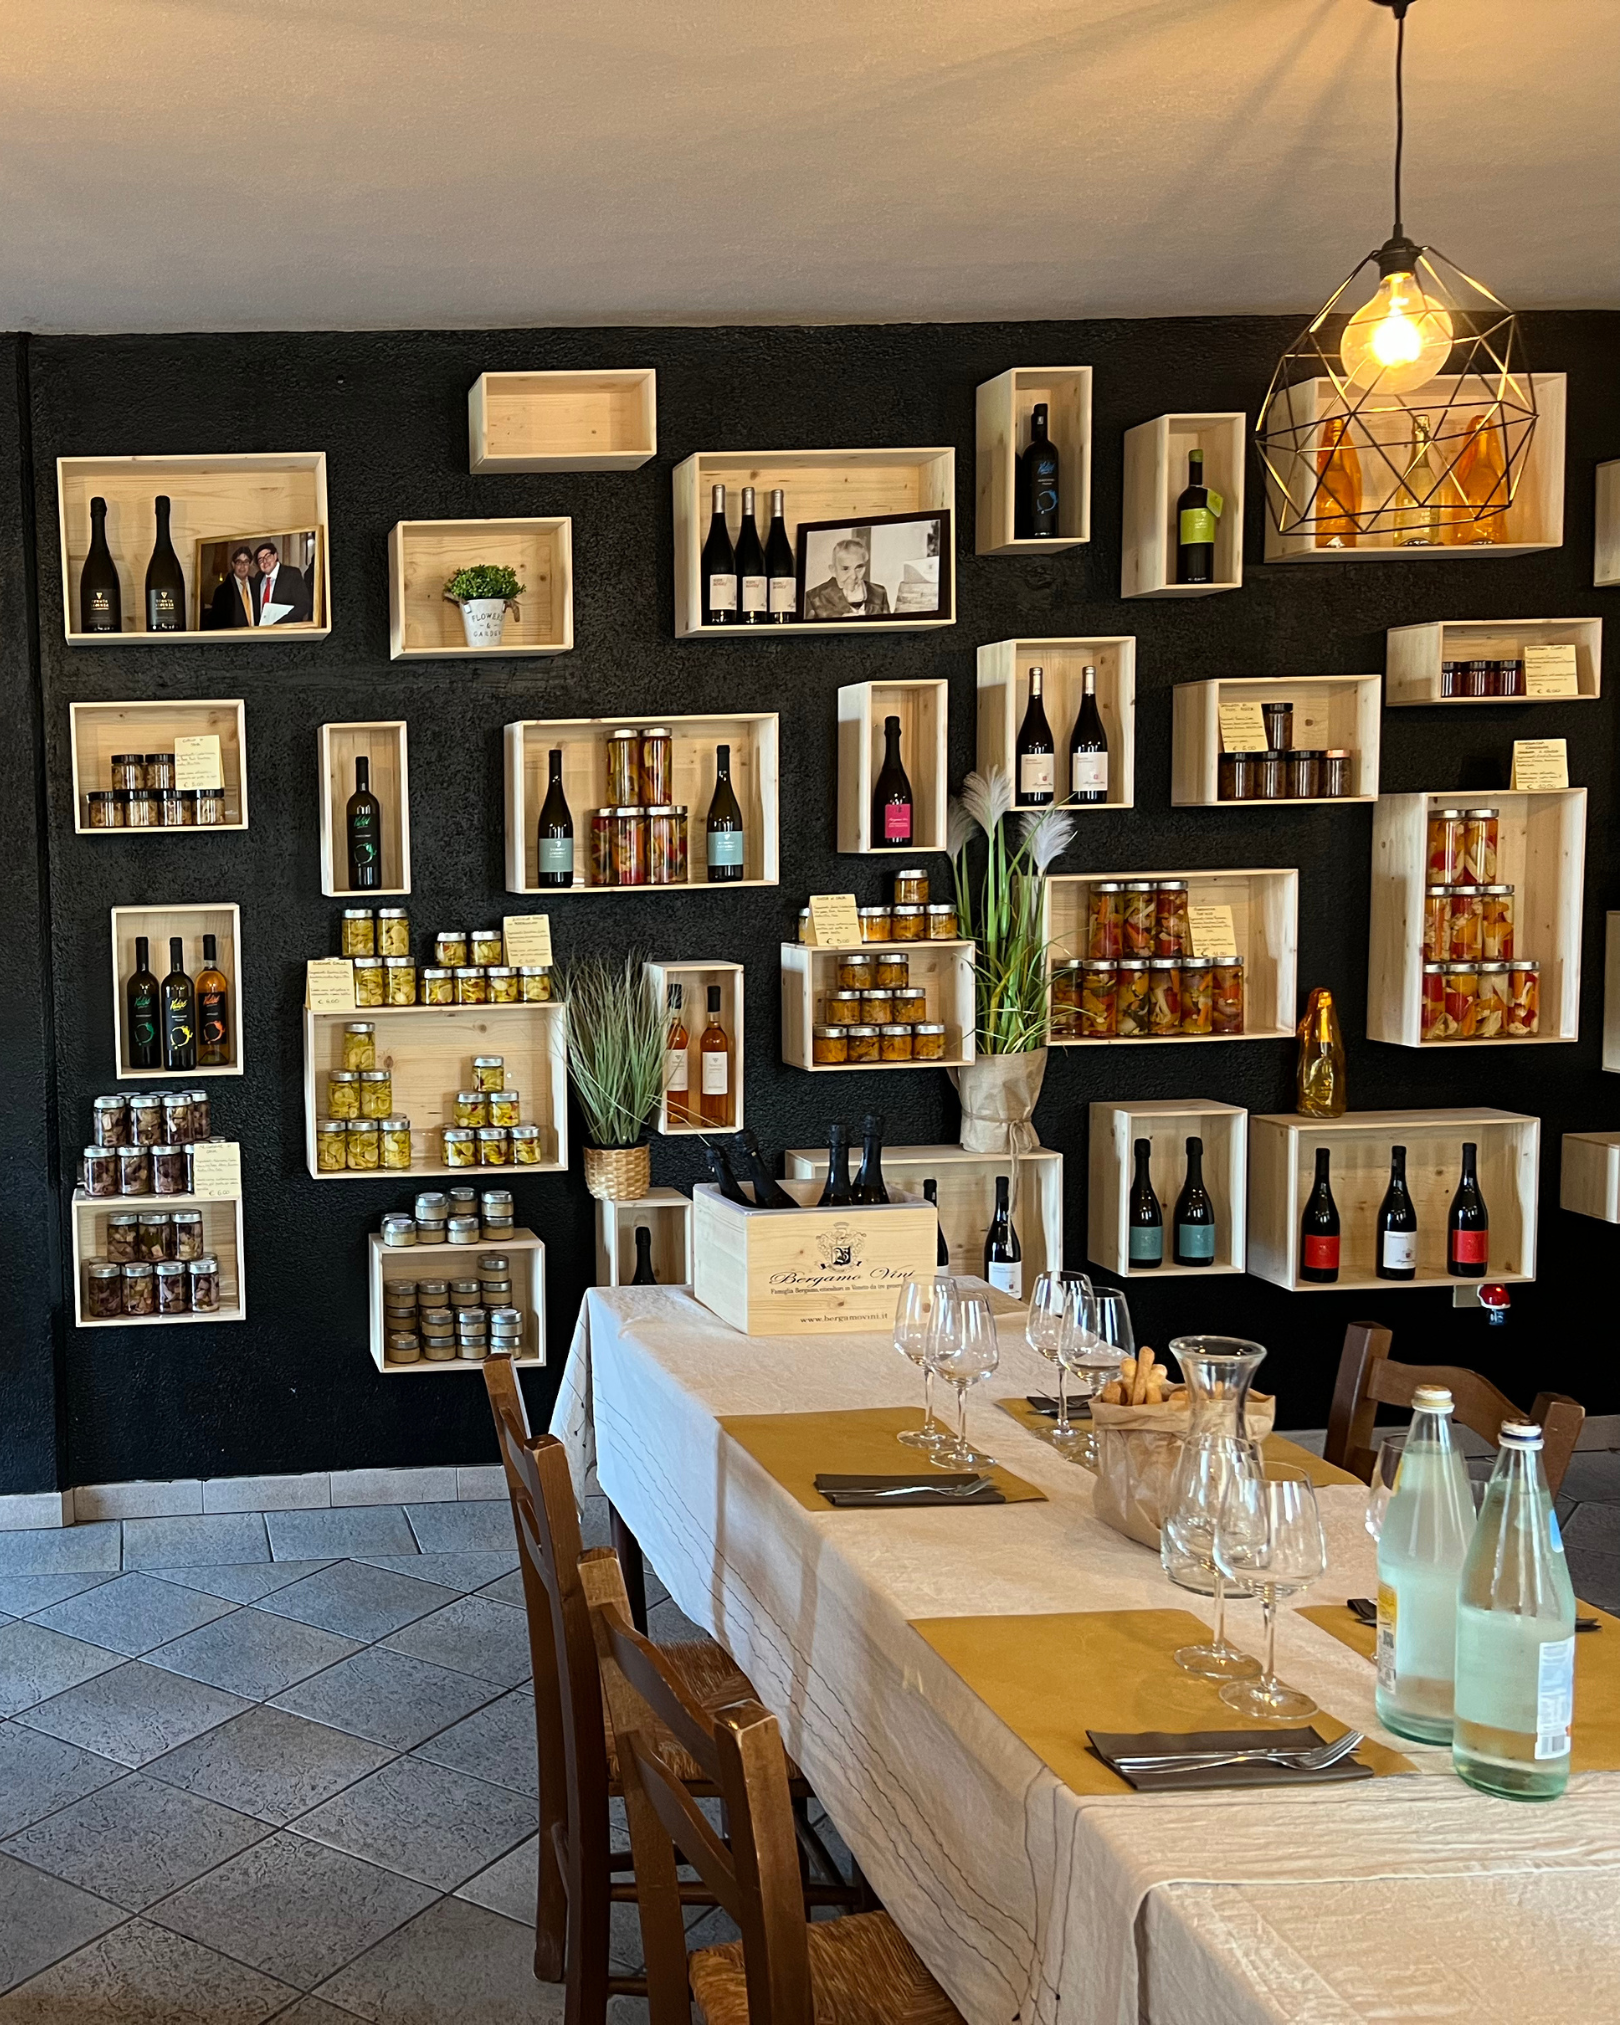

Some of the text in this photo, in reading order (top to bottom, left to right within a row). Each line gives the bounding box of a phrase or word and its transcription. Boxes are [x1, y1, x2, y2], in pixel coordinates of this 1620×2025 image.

[769, 1271, 861, 1288] Bergamo
[869, 1264, 916, 1280] Vini
[800, 1312, 888, 1323] www.bergamovini.it
